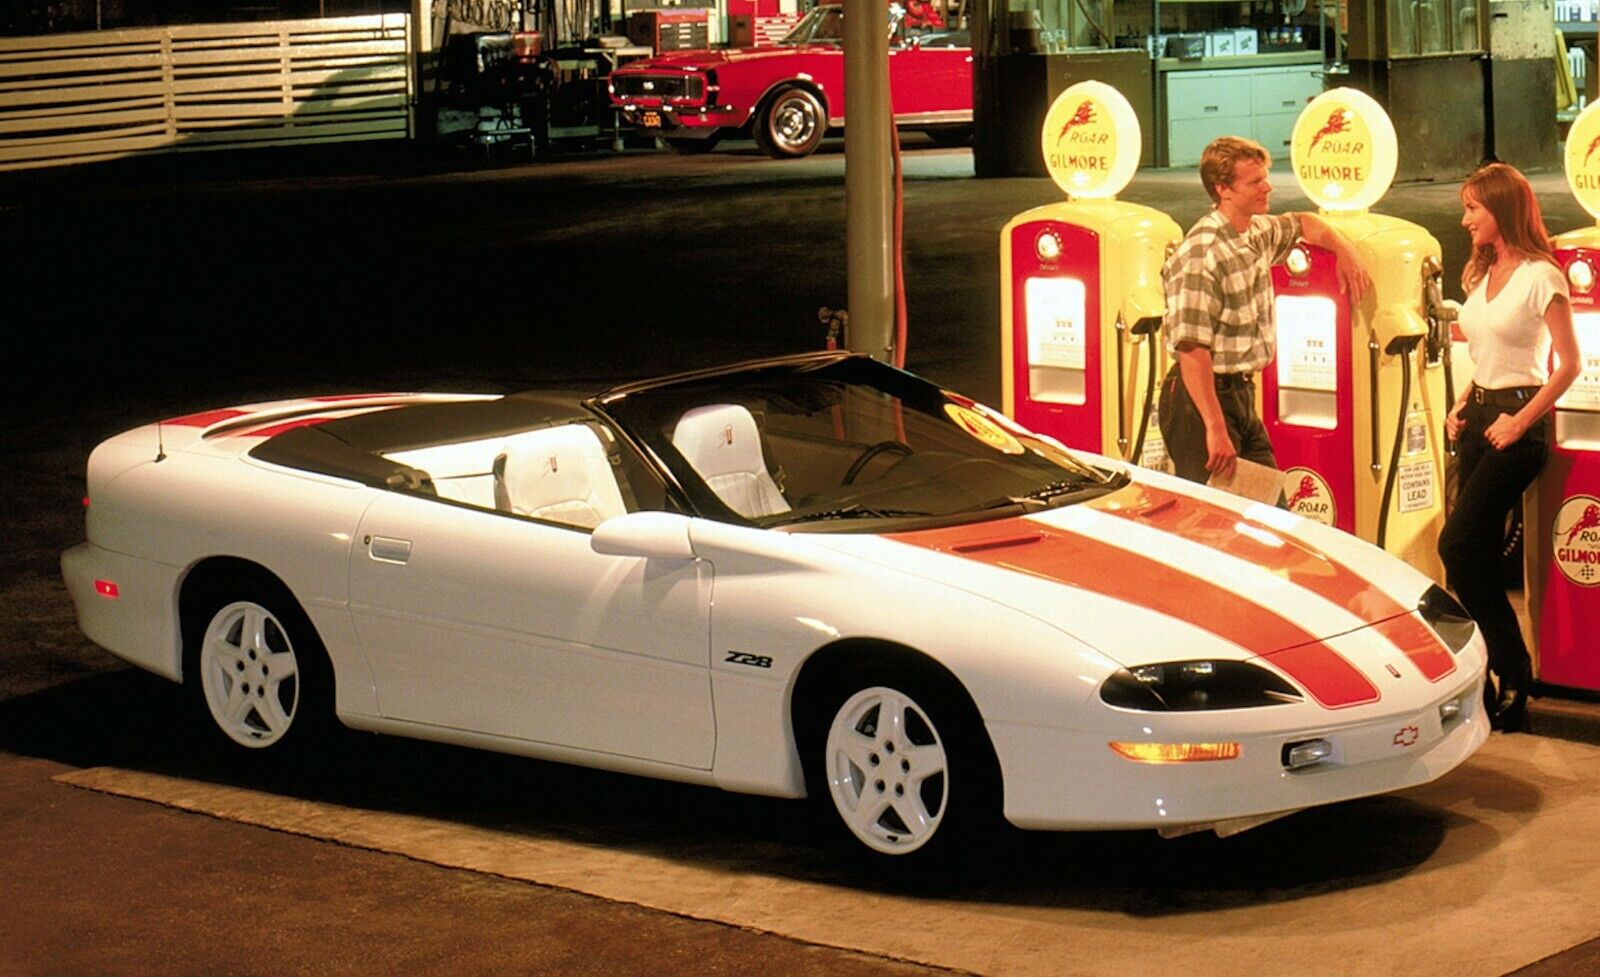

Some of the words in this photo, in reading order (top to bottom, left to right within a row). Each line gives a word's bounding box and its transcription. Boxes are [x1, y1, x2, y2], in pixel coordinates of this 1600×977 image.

[1069, 131, 1109, 145] ROAR
[1321, 140, 1364, 155] ROAR
[1050, 154, 1109, 171] GILMORE
[1300, 165, 1364, 182] GILMORE
[1403, 479, 1430, 490] CONTAINS
[1407, 489, 1427, 501] LEAD
[1298, 501, 1329, 514] ROAR
[1580, 530, 1600, 543] RO
[725, 650, 774, 669] Z28
